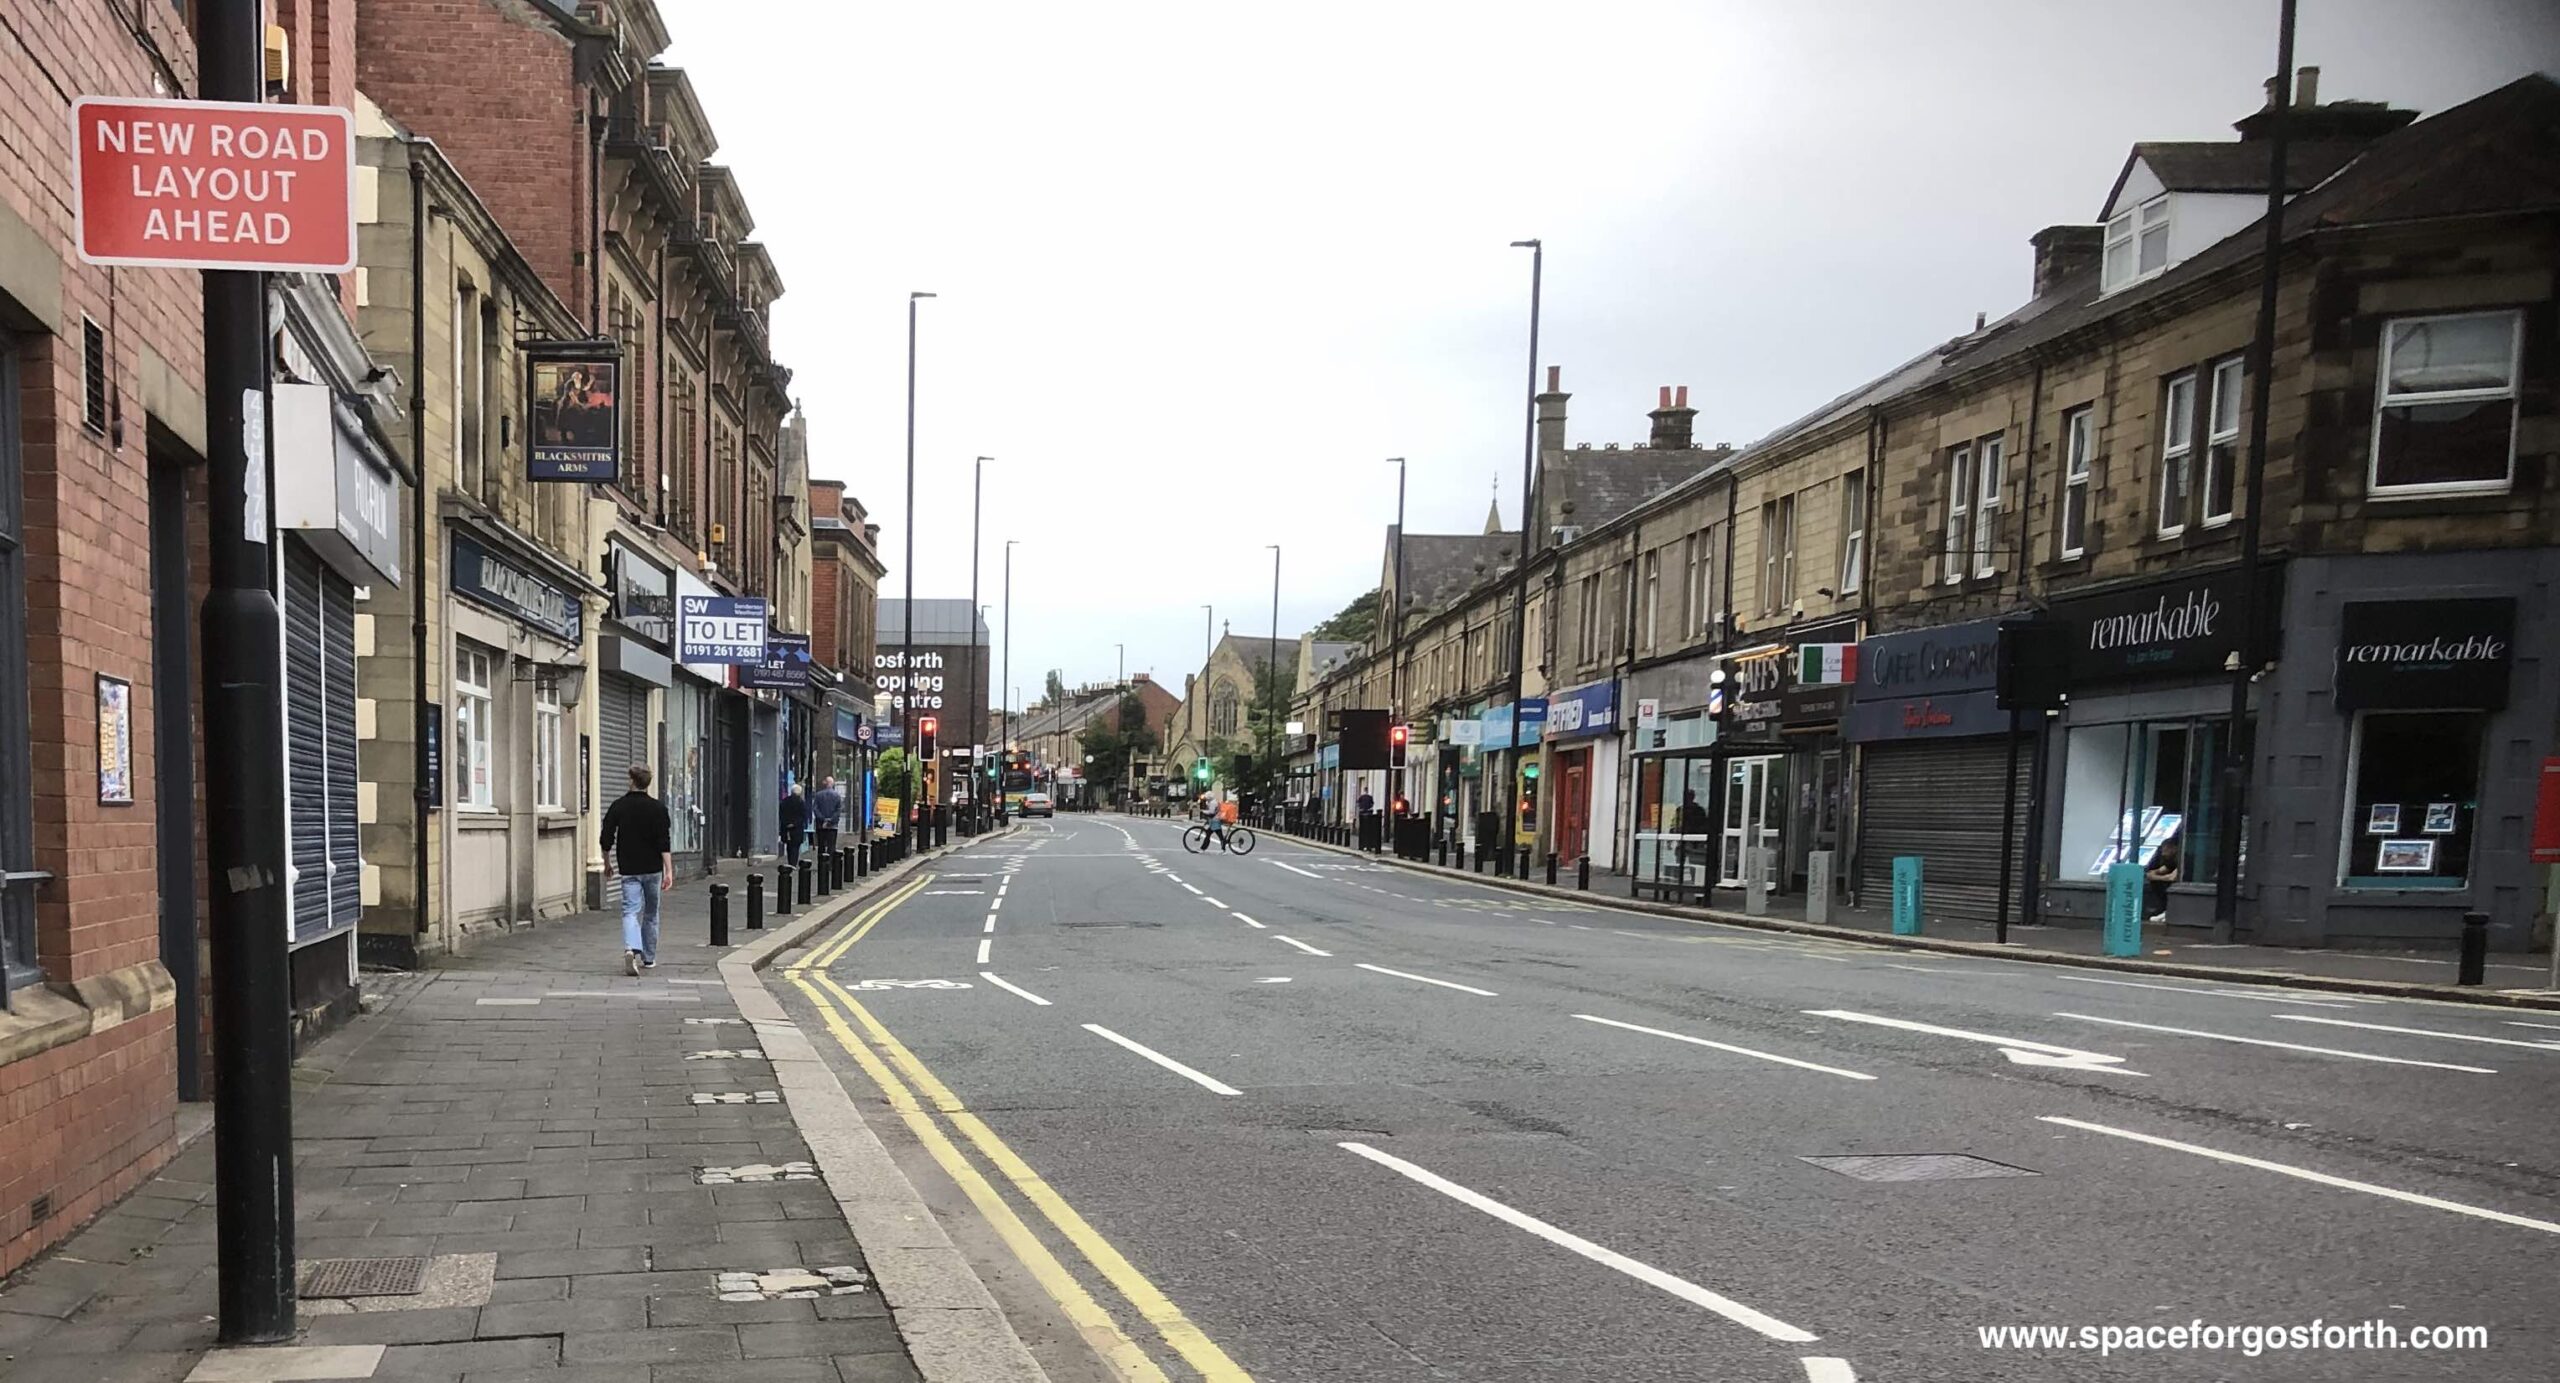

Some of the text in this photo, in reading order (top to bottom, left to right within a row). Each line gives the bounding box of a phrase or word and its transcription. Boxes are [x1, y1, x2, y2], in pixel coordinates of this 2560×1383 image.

[97, 120, 330, 161] NEW ROAD
[132, 165, 297, 202] LAYOUT
[143, 209, 292, 245] AHEAD
[534, 451, 612, 461] BLACKSMITHS
[557, 463, 589, 472] ARMS
[685, 598, 709, 614] SW
[2090, 588, 2219, 650] remarkable
[687, 621, 762, 641] TO LET
[685, 645, 762, 658] 0191 261 2681
[2346, 634, 2505, 662] remarkable
[767, 660, 785, 669] LET
